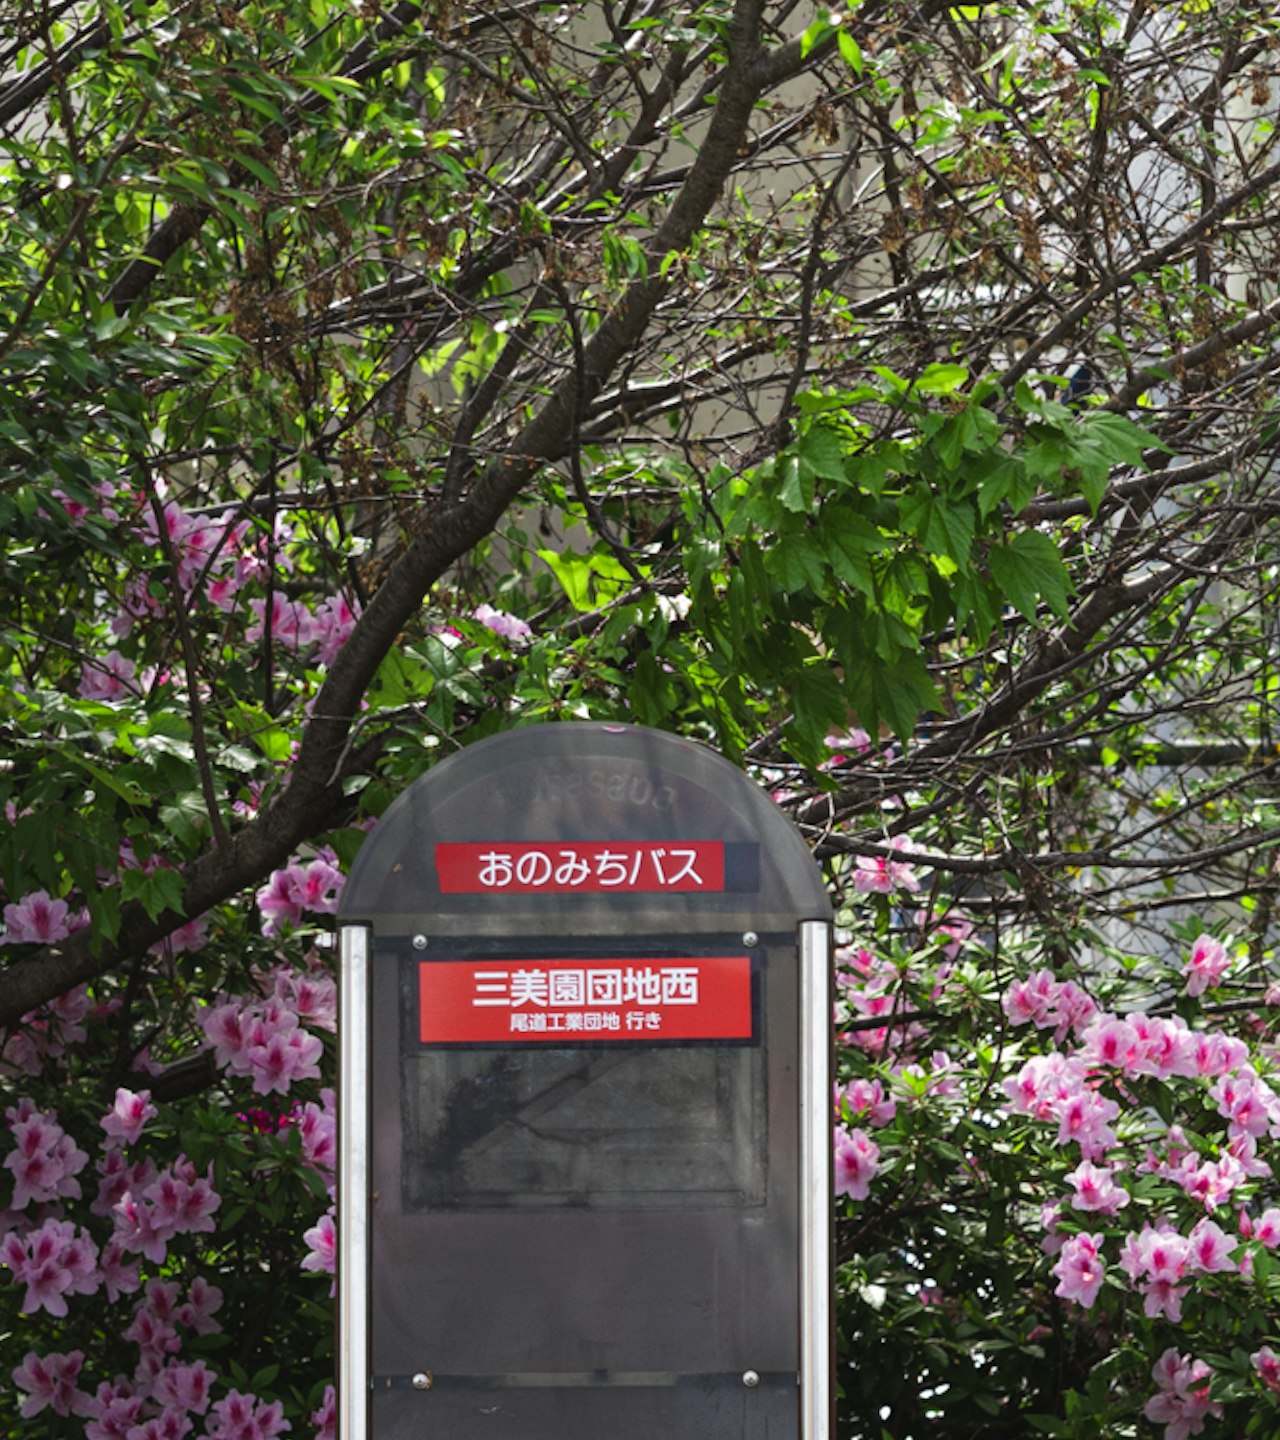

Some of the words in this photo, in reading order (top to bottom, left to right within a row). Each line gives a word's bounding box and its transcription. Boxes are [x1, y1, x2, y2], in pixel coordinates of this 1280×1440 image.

[477, 848, 704, 887] おのみちバス
[472, 967, 699, 1007] 三美園団地西
[509, 1012, 621, 1032] 尾道工業団地
[625, 1012, 663, 1030] 行き
